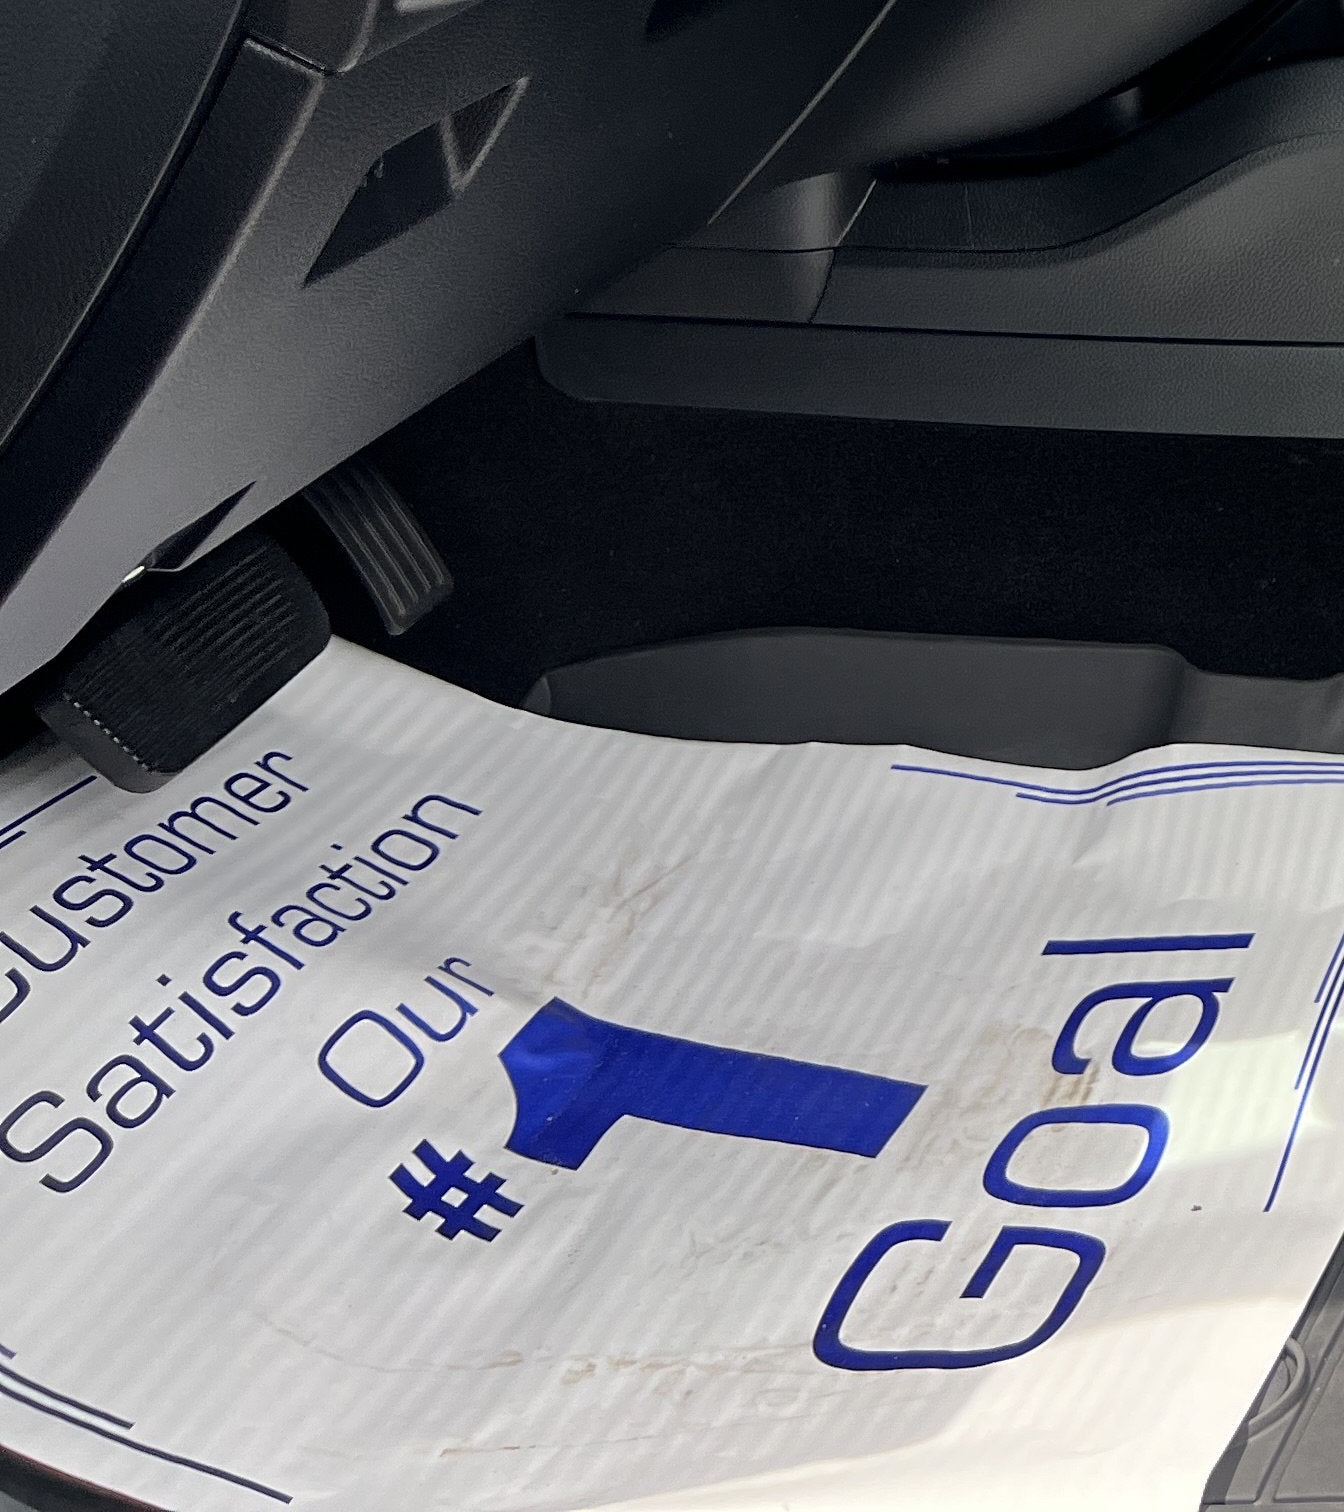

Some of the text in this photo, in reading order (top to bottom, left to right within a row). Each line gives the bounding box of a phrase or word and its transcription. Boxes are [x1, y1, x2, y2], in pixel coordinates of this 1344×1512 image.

[1, 794, 483, 1194] Satisfaction
[318, 954, 495, 1108] Our
[812, 933, 1256, 1370] Goal
